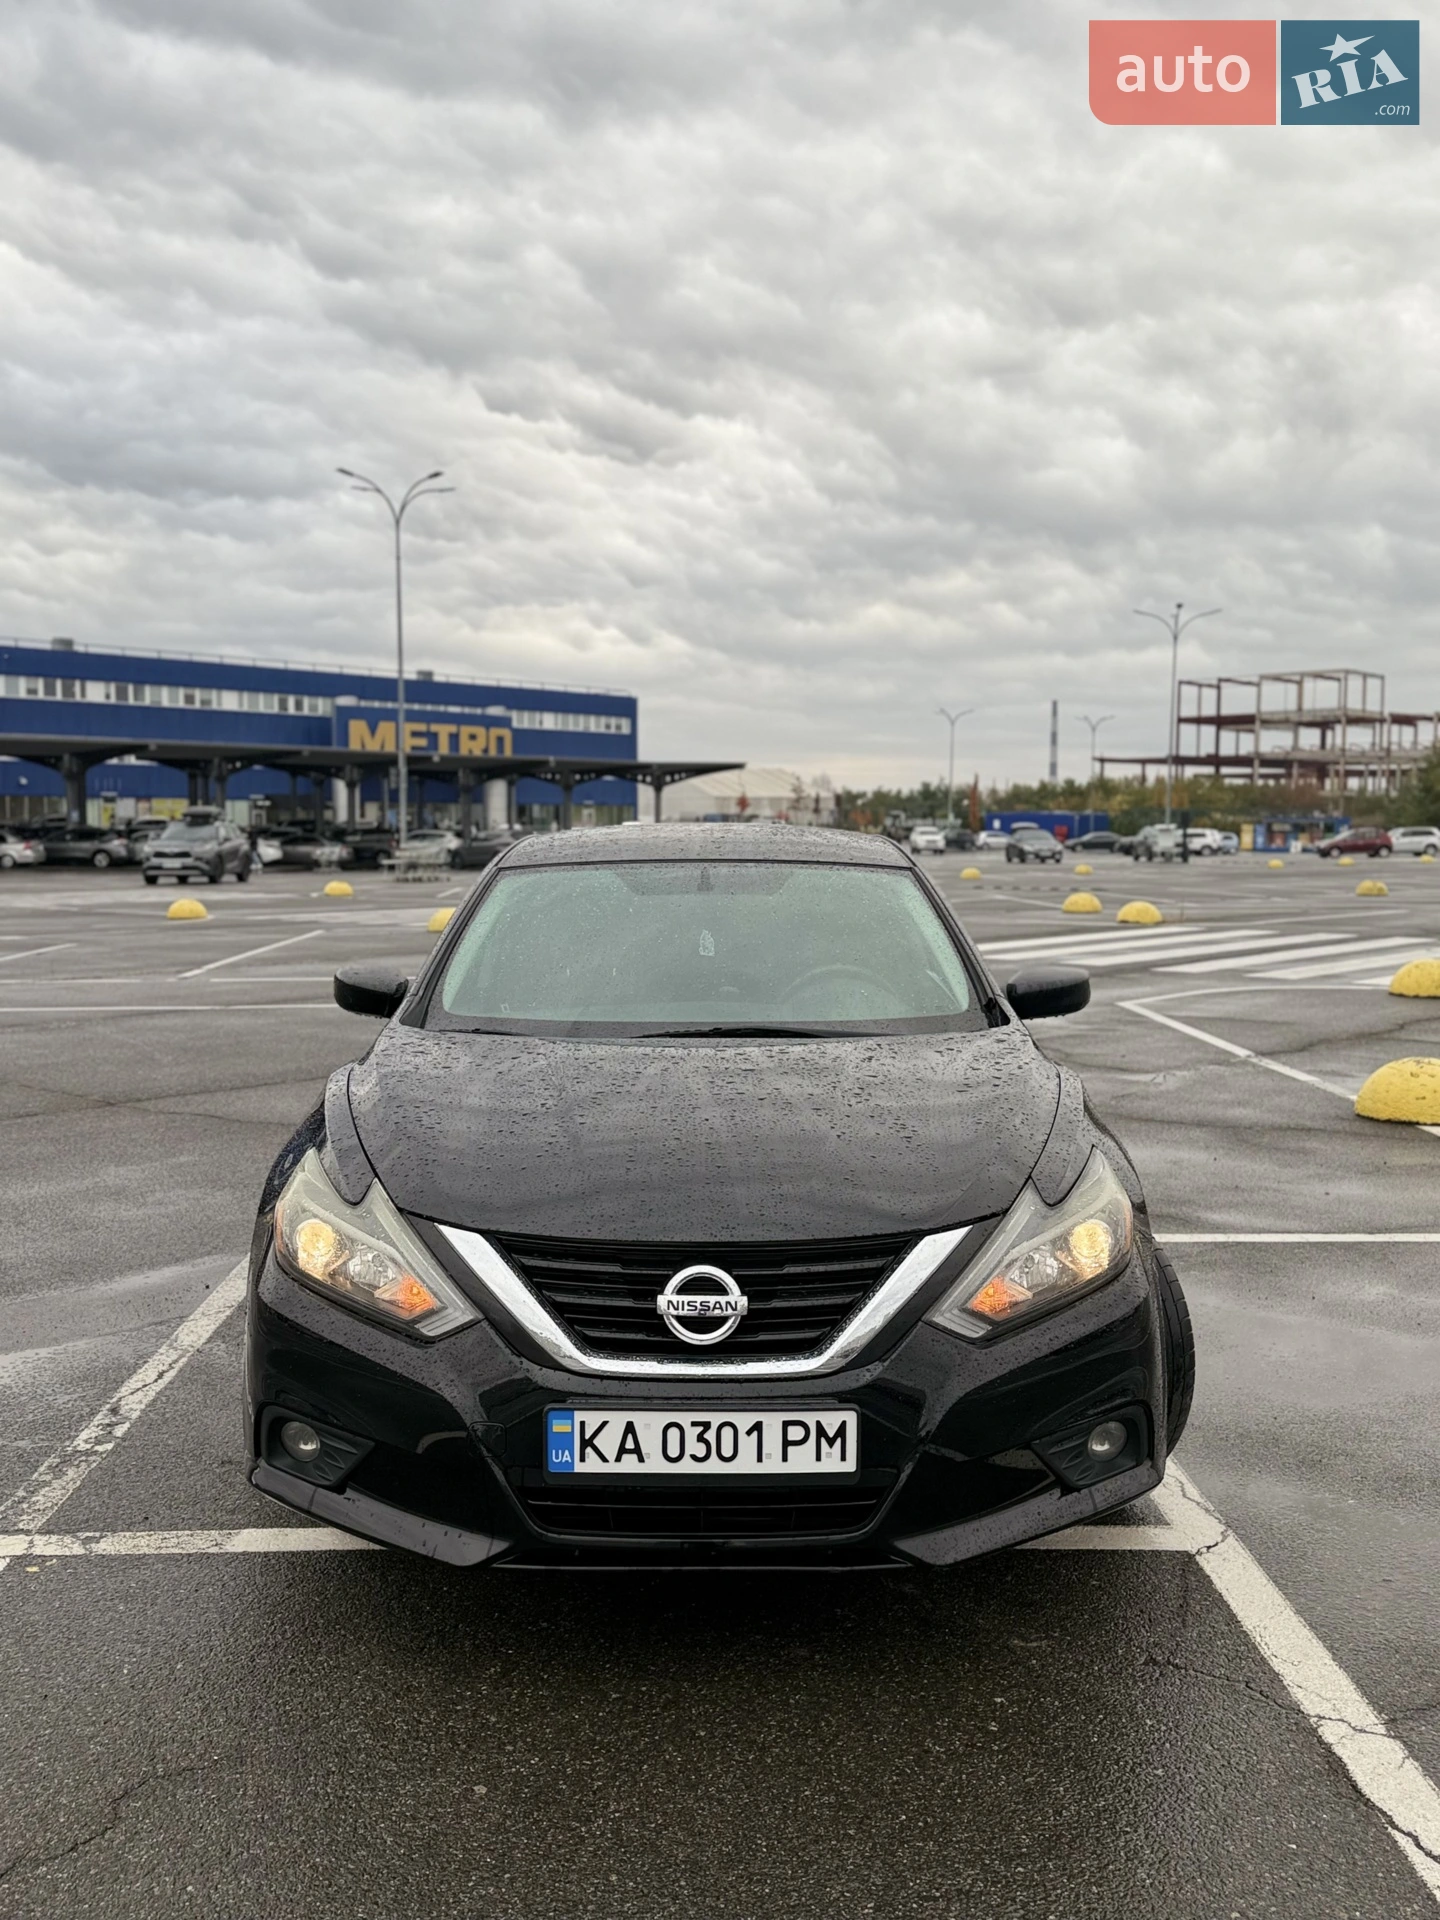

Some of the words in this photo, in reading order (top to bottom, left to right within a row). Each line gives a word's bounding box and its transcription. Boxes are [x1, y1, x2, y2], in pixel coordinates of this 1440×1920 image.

[666, 1299, 739, 1313] NISSAN
[578, 1419, 646, 1463] KA
[661, 1420, 764, 1463] 0301
[781, 1419, 847, 1463] PM
[552, 1450, 572, 1463] UA
